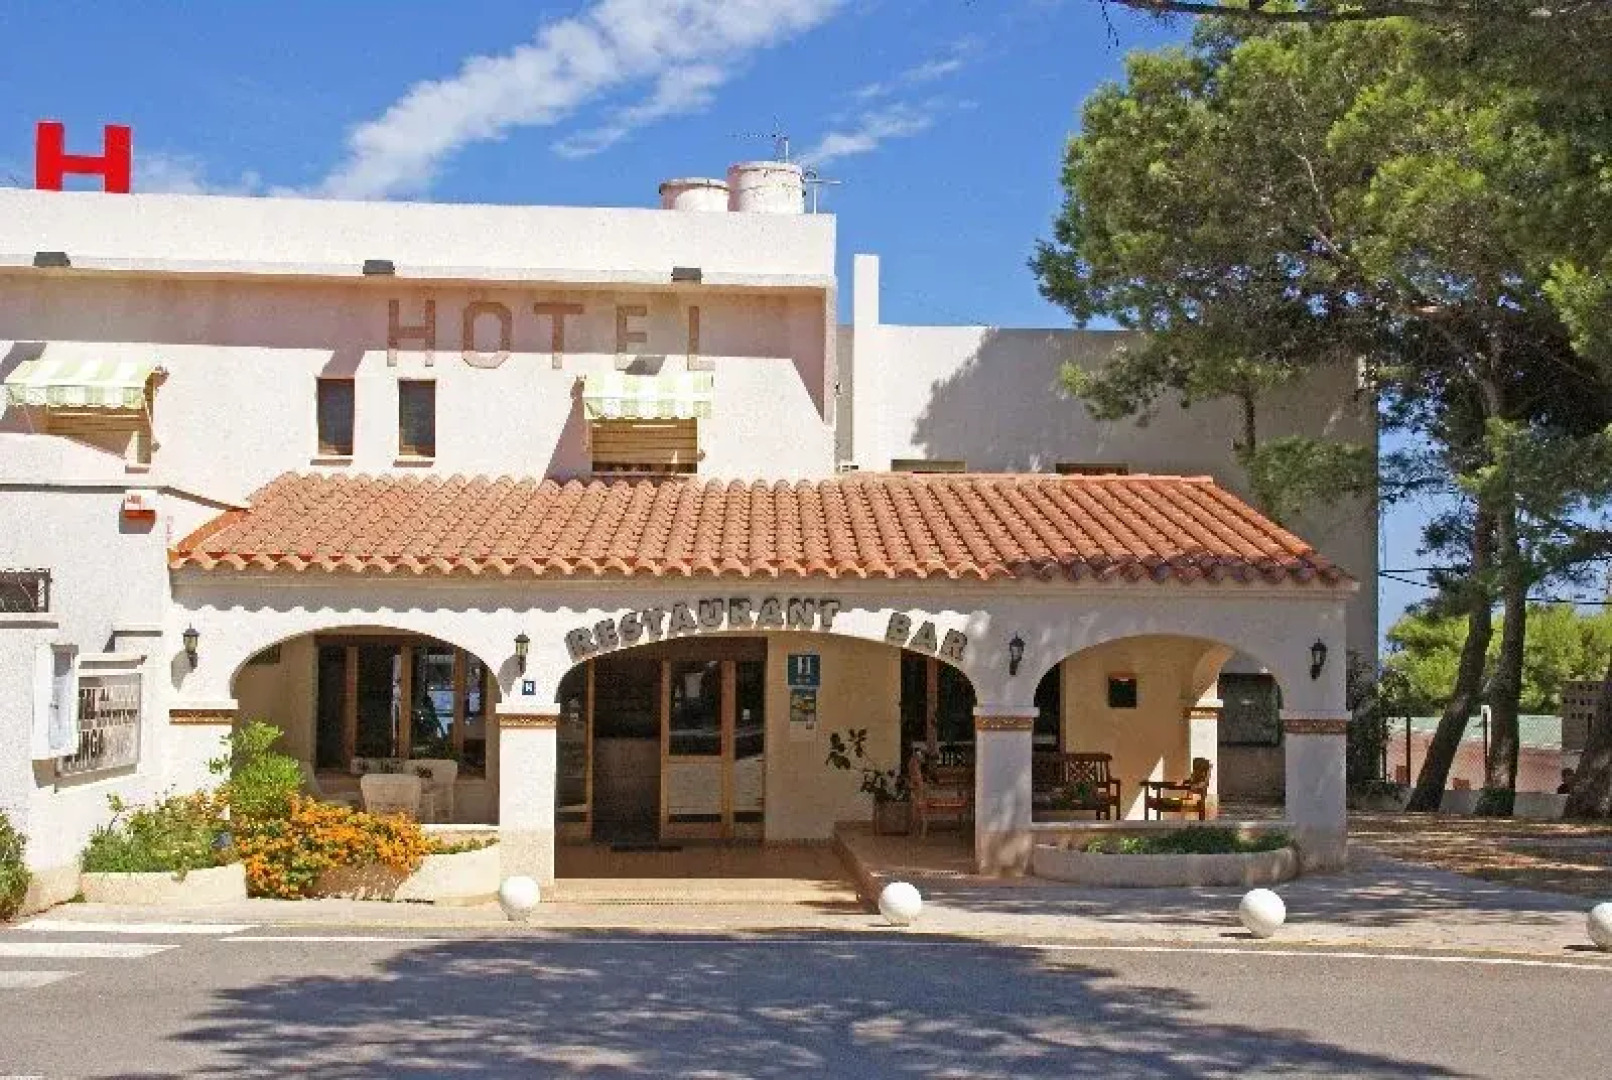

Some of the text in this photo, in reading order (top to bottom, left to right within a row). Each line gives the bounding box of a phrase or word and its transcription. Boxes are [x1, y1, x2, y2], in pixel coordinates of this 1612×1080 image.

[36, 121, 132, 194] H
[386, 299, 715, 371] HOTEL
[564, 597, 968, 662] RESTAURANT BAR
